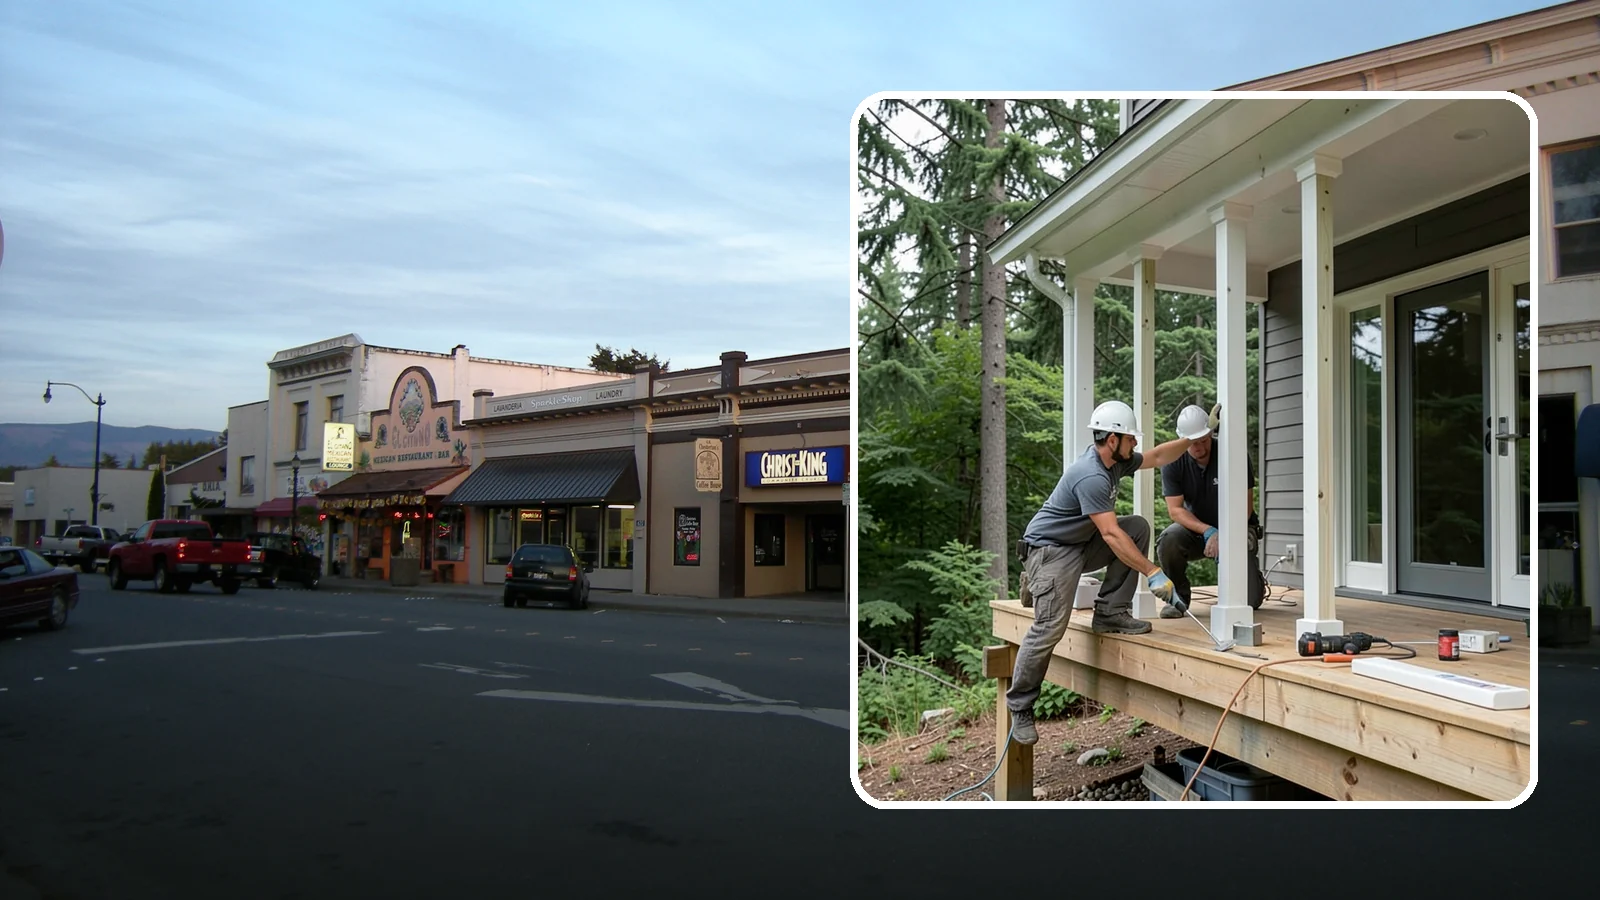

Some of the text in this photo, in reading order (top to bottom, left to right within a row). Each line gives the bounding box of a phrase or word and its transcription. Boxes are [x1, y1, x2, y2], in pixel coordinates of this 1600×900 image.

[493, 389, 623, 413] LAVANDERIA Sparkle Shop LAUNDRY
[374, 454, 396, 464] MEXICAN
[398, 451, 434, 463] RESTAURANT
[438, 450, 450, 459] BAR
[799, 450, 828, 476] KING
